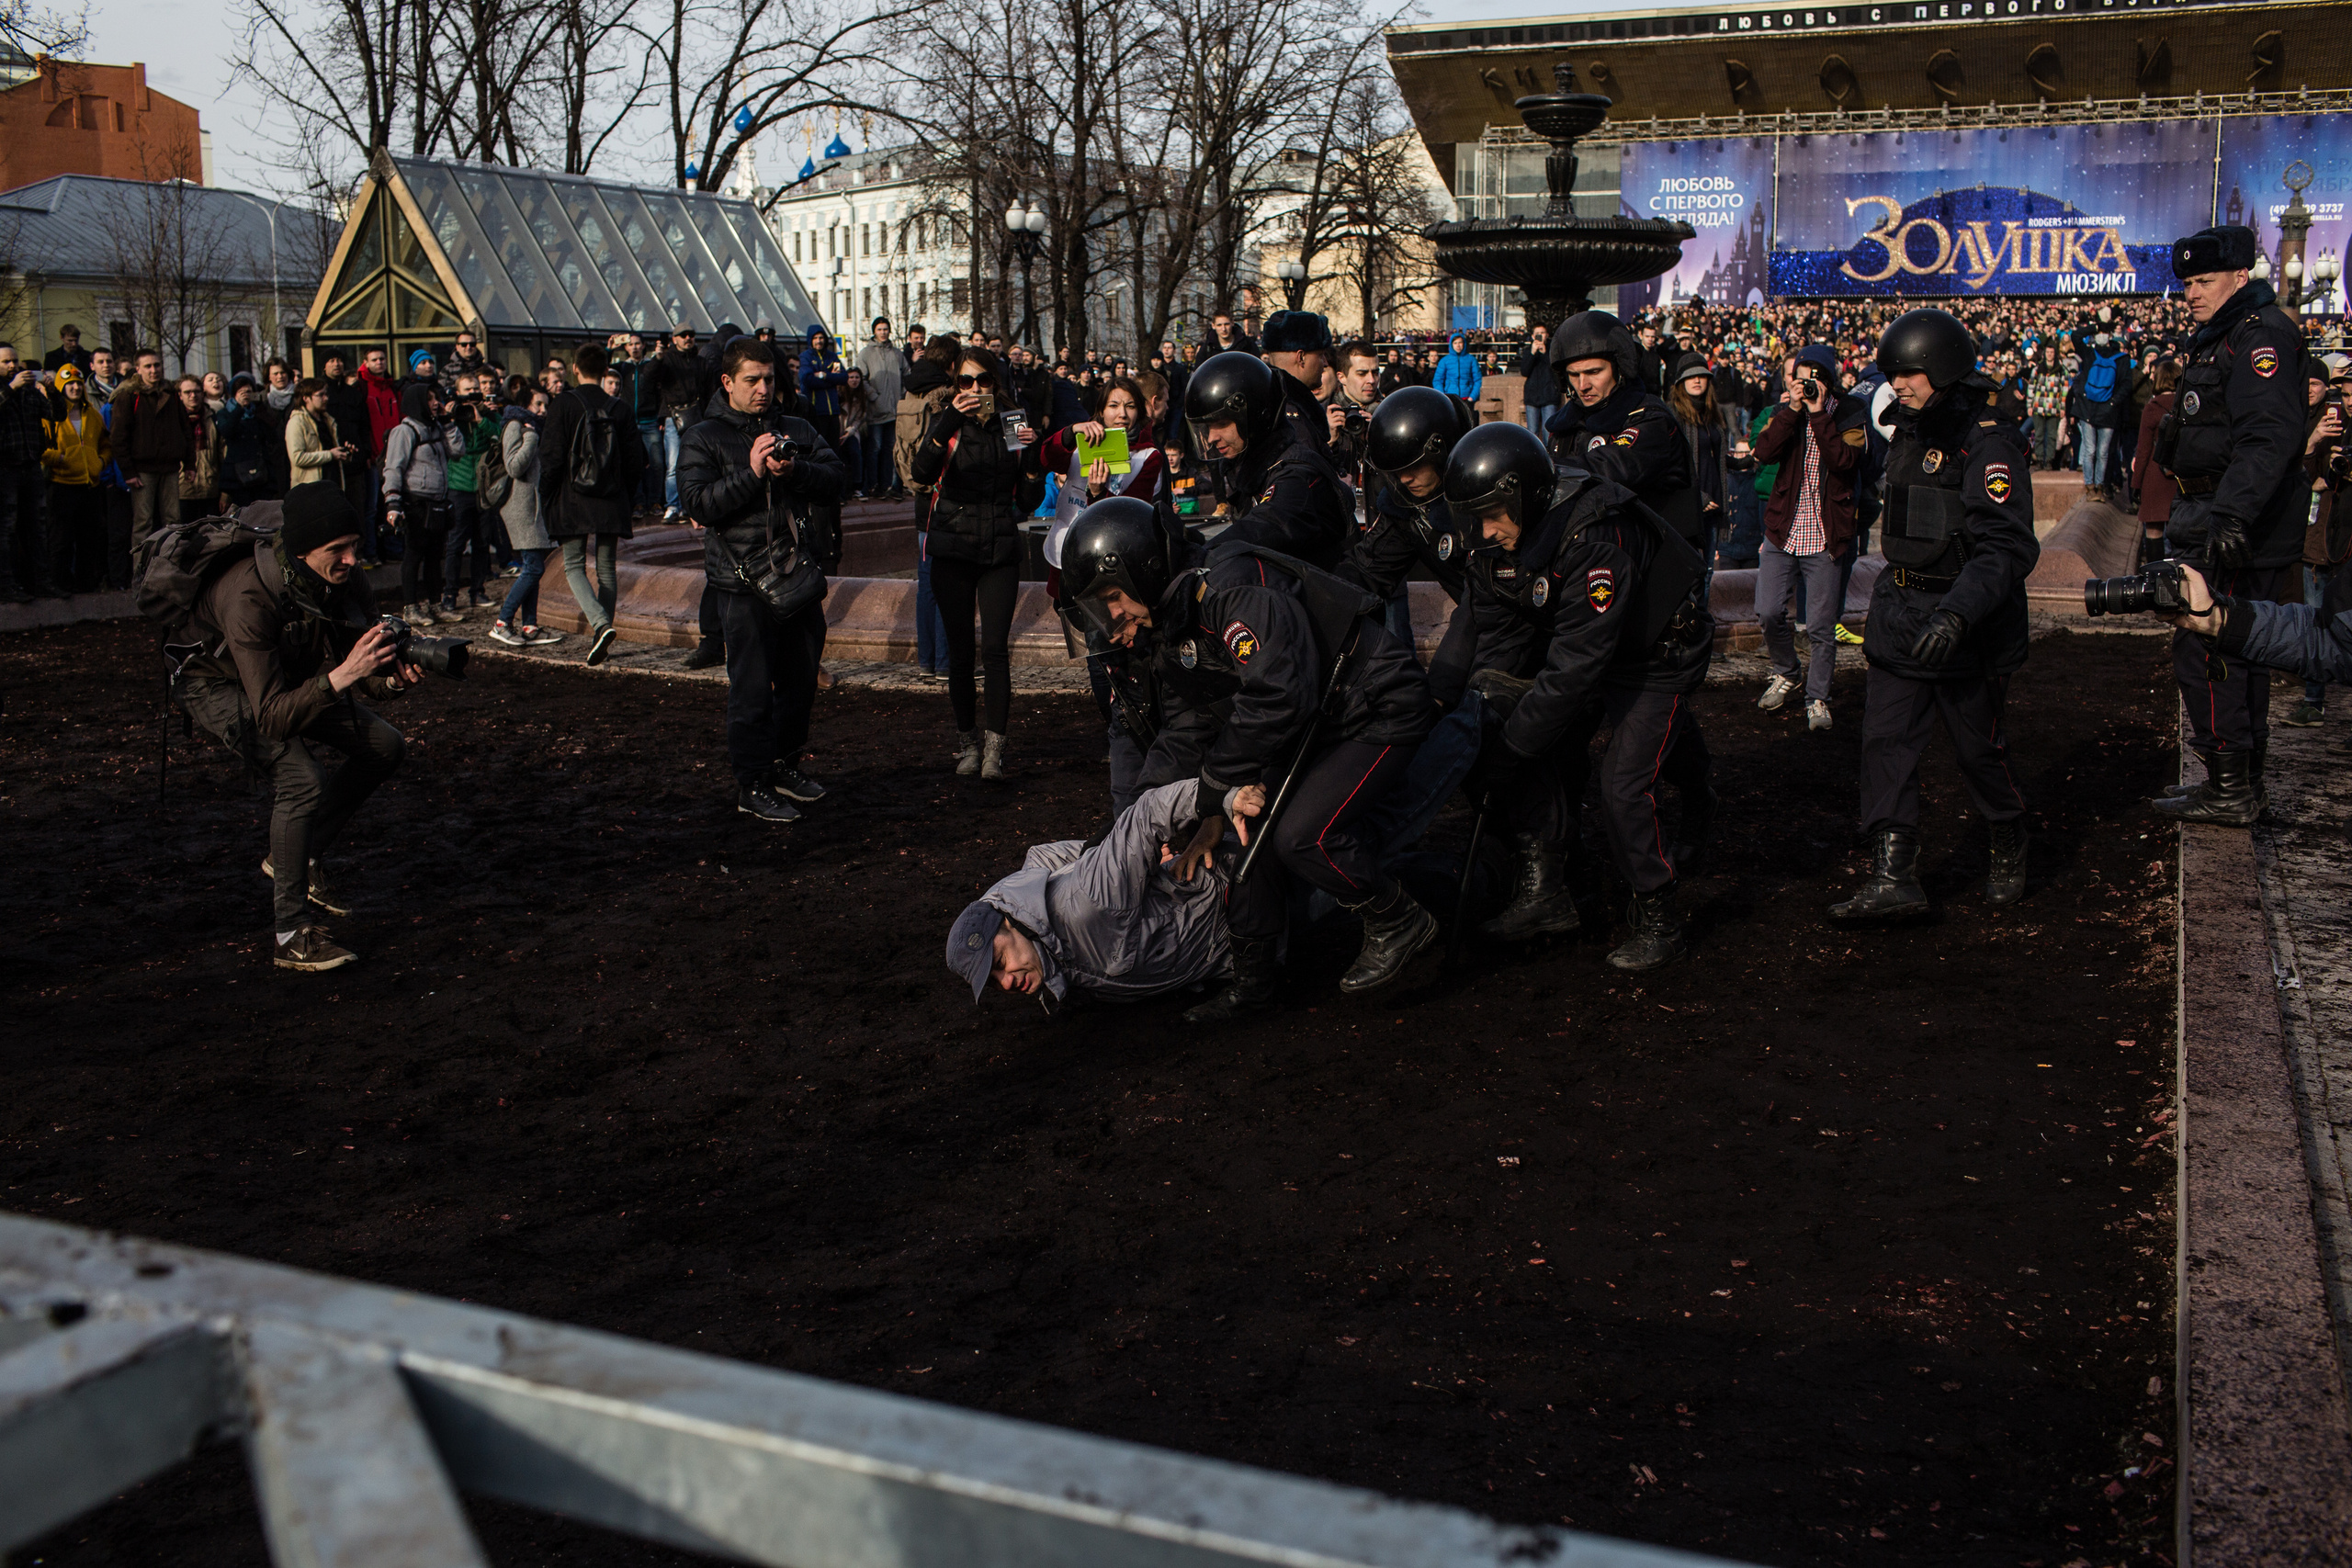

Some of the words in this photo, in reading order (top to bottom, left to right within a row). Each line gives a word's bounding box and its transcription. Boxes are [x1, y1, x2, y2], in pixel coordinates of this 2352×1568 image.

[1718, 11, 1837, 30] ЛЮБОВЬ
[1871, 8, 1882, 21] С
[1915, 0, 2065, 18] ПЕРВОГО
[1658, 176, 1735, 193] ЛЮБОВЬ
[1649, 196, 1661, 210] С
[1666, 193, 1744, 209] ПЕРВОГО
[2319, 203, 2344, 213] 3737
[2055, 273, 2137, 293] МЮЗИКЛ
[1590, 579, 1611, 588] РОССИЯ
[1231, 631, 1249, 650] РОССИЯ
